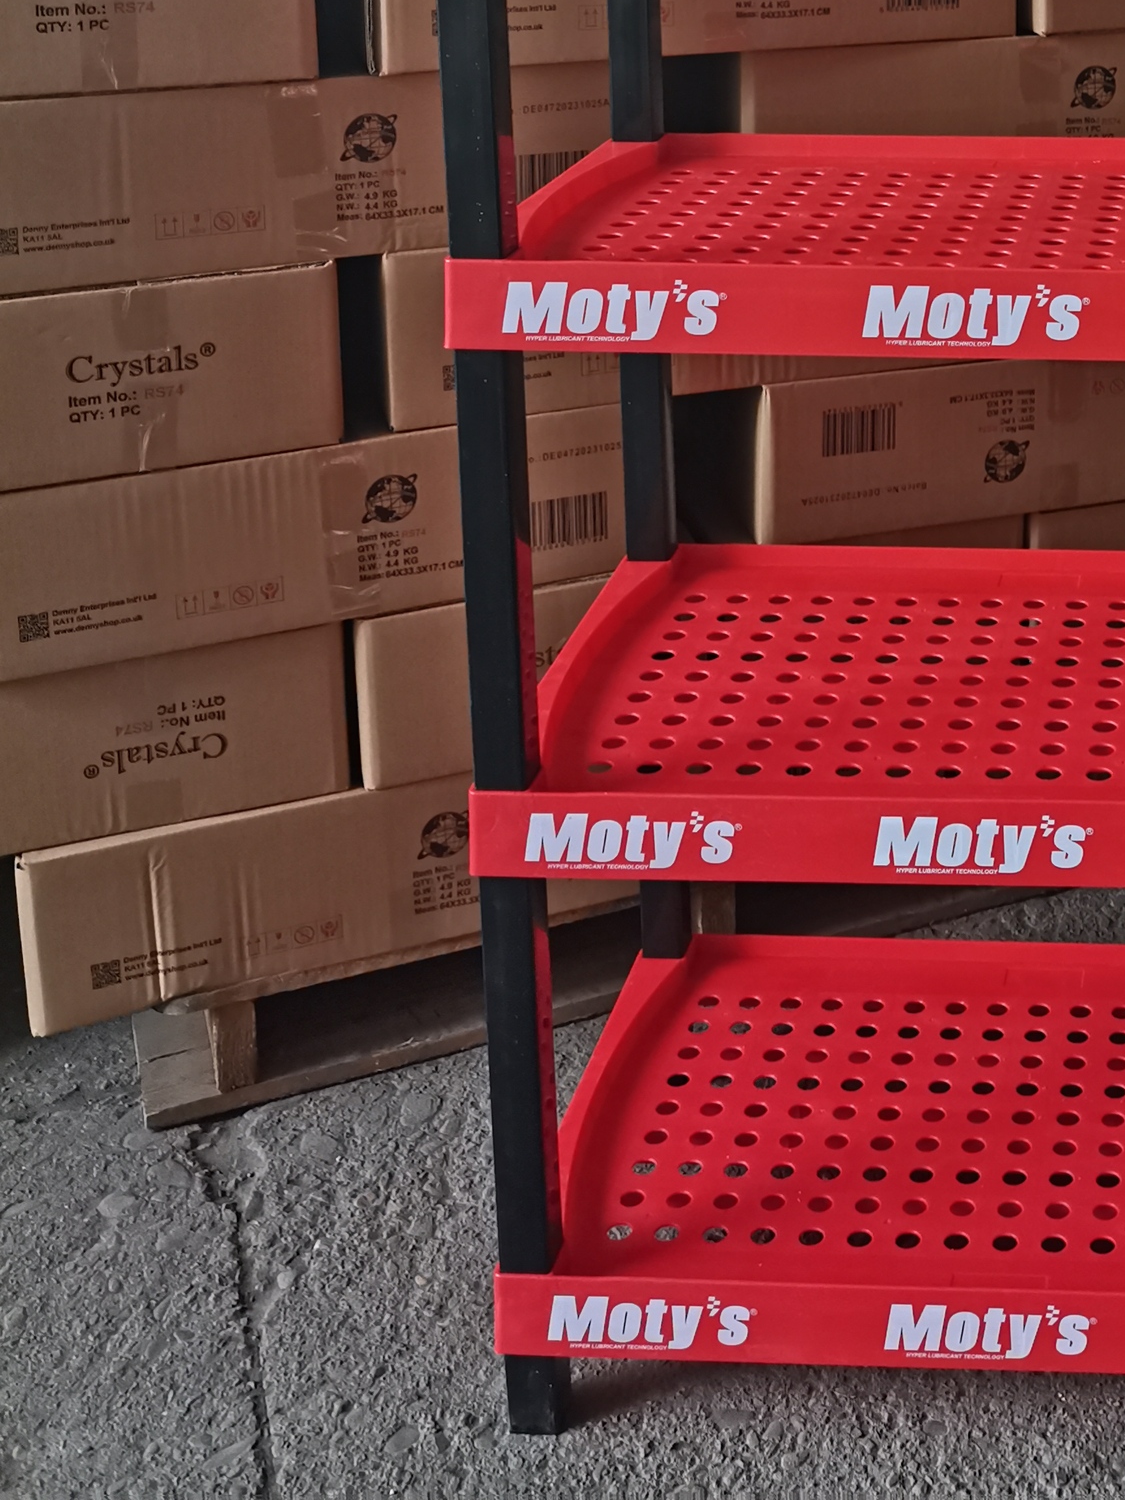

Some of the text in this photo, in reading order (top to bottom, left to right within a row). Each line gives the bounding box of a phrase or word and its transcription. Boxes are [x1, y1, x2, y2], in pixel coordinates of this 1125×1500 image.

[35, 1, 155, 17] Item No.: RS74
[36, 19, 110, 33] QTY: 1 PC
[364, 192, 378, 200] 4.9
[383, 189, 398, 199] KG
[365, 202, 378, 210] 4.4
[383, 200, 398, 208] KG
[428, 205, 444, 214] CM
[68, 384, 184, 408] Item No.: RS74
[69, 405, 140, 423] QTY: 1 PC
[157, 695, 226, 715] QTY: 1 PC
[161, 716, 190, 728] No.:
[195, 710, 226, 723] Item
